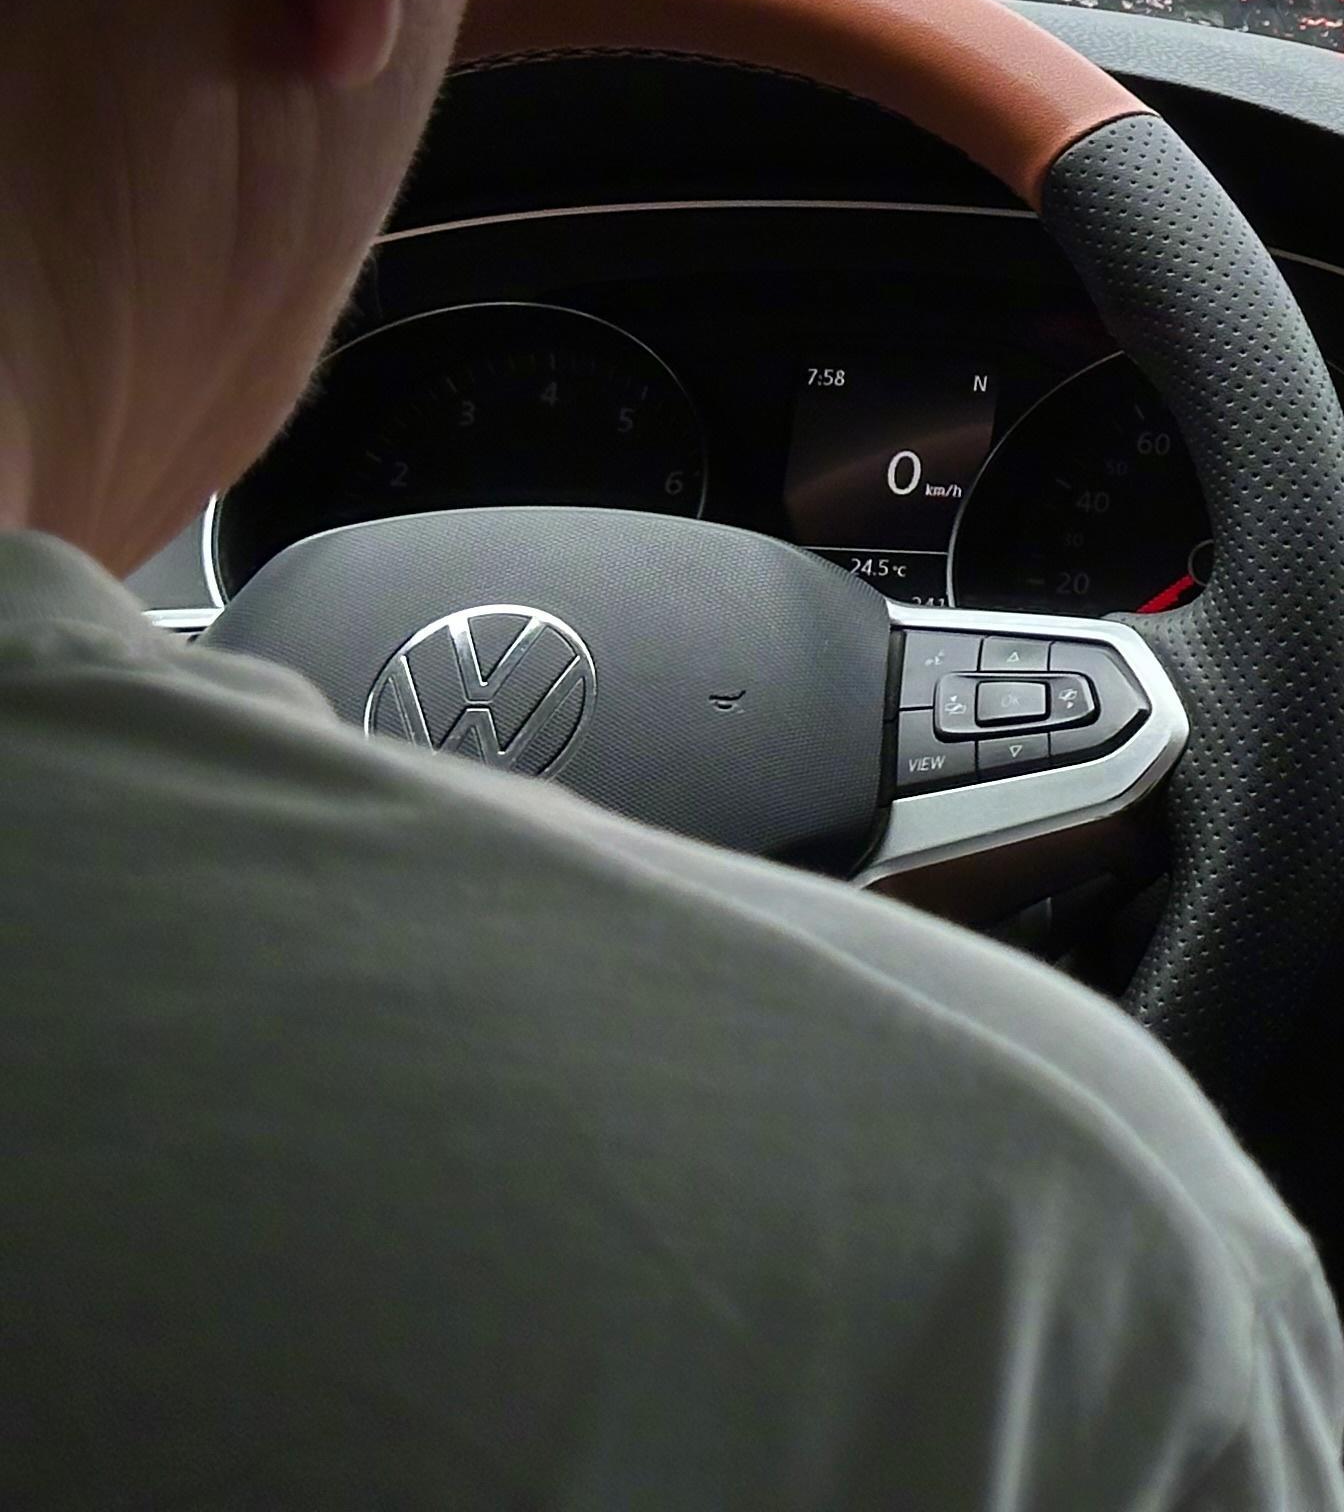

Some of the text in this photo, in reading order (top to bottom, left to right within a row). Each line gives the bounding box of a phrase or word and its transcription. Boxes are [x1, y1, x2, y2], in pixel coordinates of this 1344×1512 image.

[807, 368, 846, 387] 7:58
[973, 374, 988, 393] N
[541, 382, 558, 407] 4
[460, 400, 476, 428] 3
[617, 407, 635, 433] 5
[1136, 431, 1171, 456] 60
[390, 462, 409, 488] 2
[664, 469, 685, 496] 6
[887, 450, 963, 499] 0 km/h
[1075, 490, 1110, 514] 40
[1056, 571, 1091, 595] 20
[908, 755, 946, 773] VIEW
